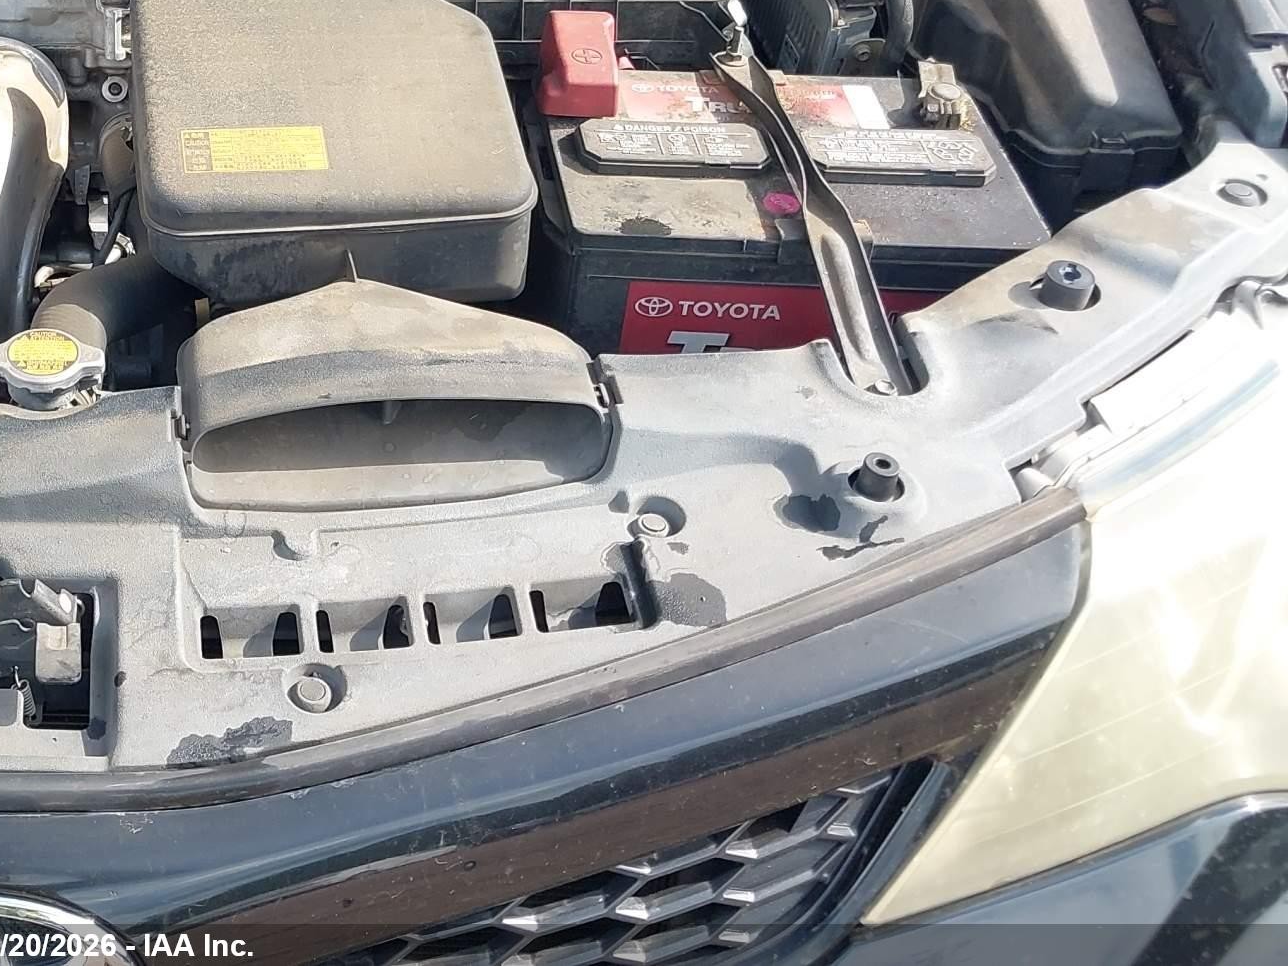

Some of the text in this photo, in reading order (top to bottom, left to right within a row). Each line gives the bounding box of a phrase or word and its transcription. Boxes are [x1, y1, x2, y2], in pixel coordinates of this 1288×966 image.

[656, 84, 719, 93] TOYOTA
[625, 124, 672, 133] DANGER
[681, 125, 726, 134] POISON
[678, 300, 781, 320] TOYOTA
